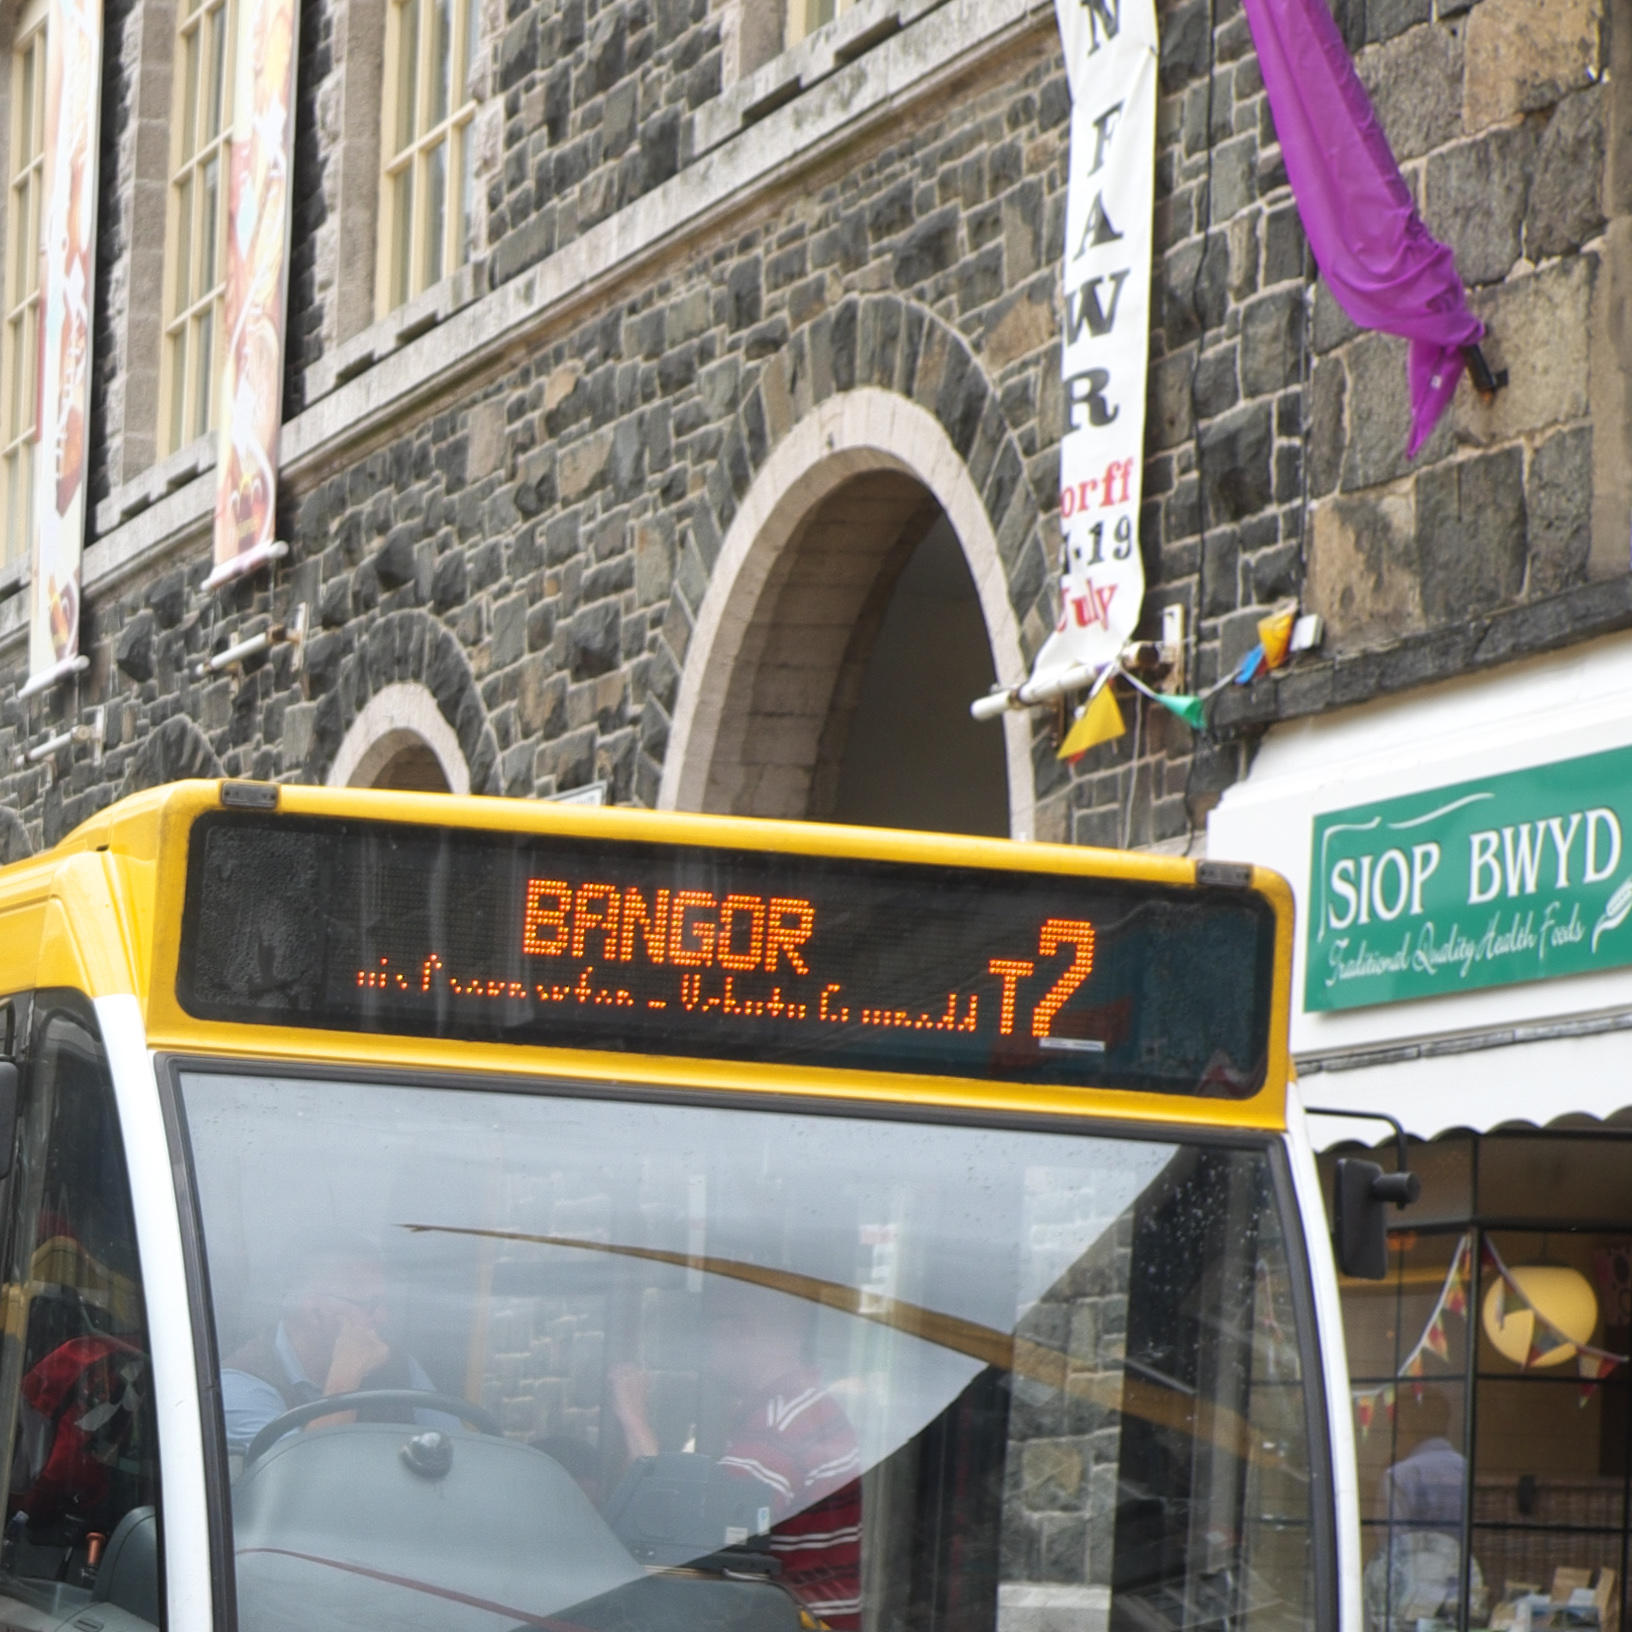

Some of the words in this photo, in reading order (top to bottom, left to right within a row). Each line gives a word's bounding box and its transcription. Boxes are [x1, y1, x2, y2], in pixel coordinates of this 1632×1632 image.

[1328, 841, 1441, 930] SIOP
[1467, 806, 1623, 905] BWYD
[523, 878, 815, 976] BANGOR
[987, 918, 1096, 1038] T2
[1324, 930, 1410, 987] Traditional
[1410, 921, 1476, 979] Quality
[1473, 910, 1536, 962] Health
[1537, 900, 1586, 960] Foods
